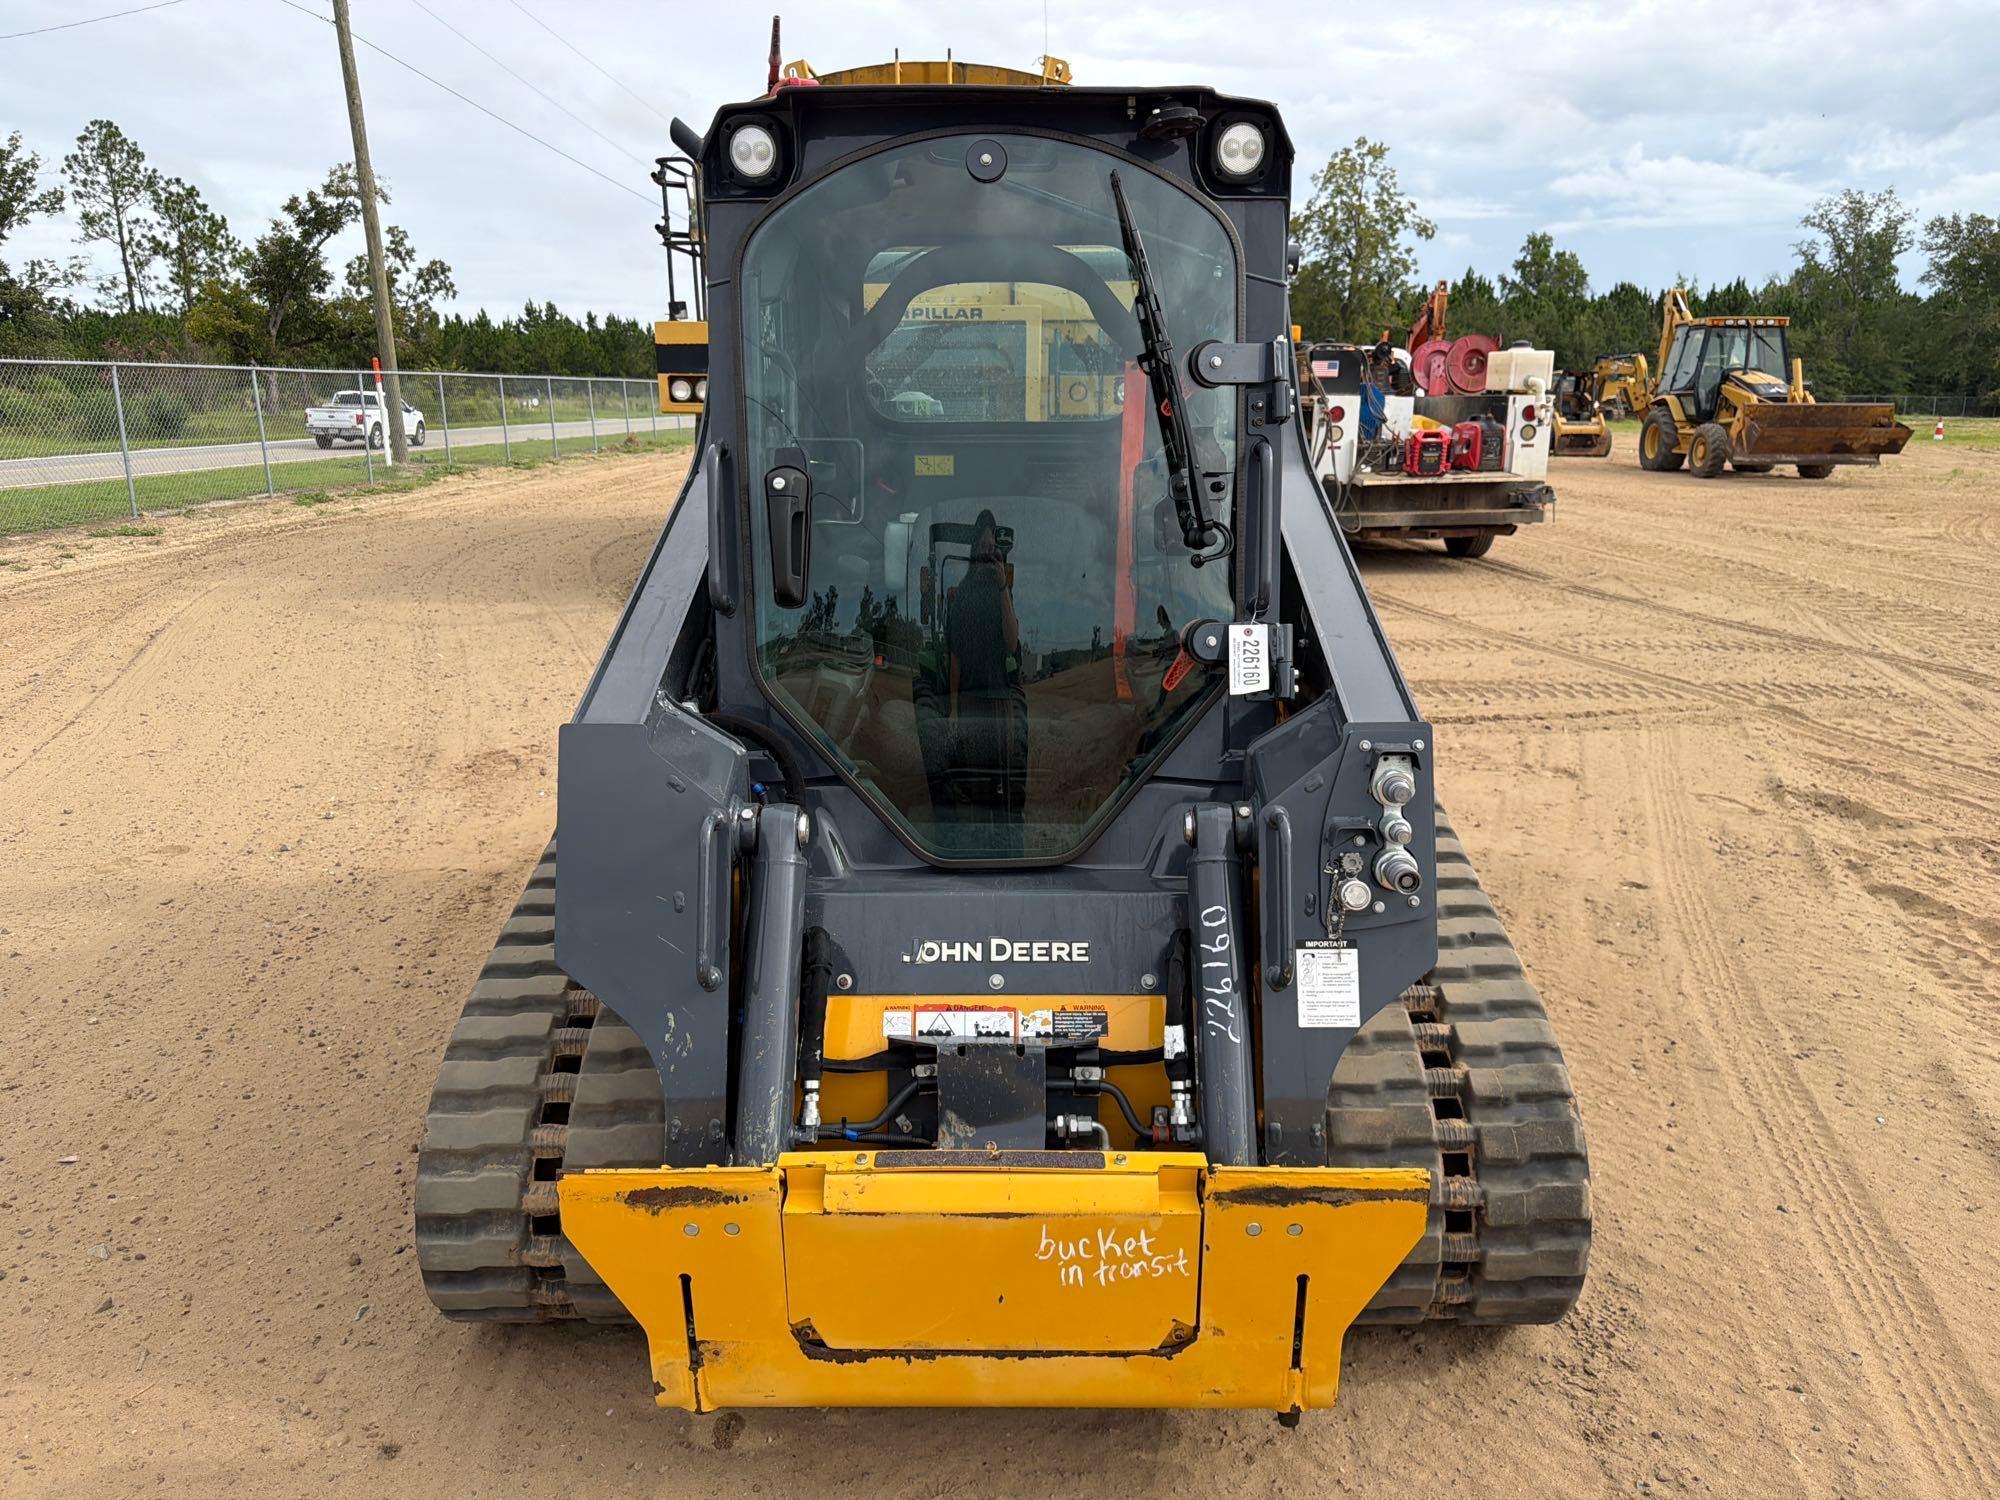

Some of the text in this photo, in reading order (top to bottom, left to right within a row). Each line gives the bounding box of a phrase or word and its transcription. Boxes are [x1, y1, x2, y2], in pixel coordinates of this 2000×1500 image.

[1243, 640, 1260, 686] 226160
[990, 938, 1089, 962] DEERE
[1058, 1247, 1190, 1288] in transit
